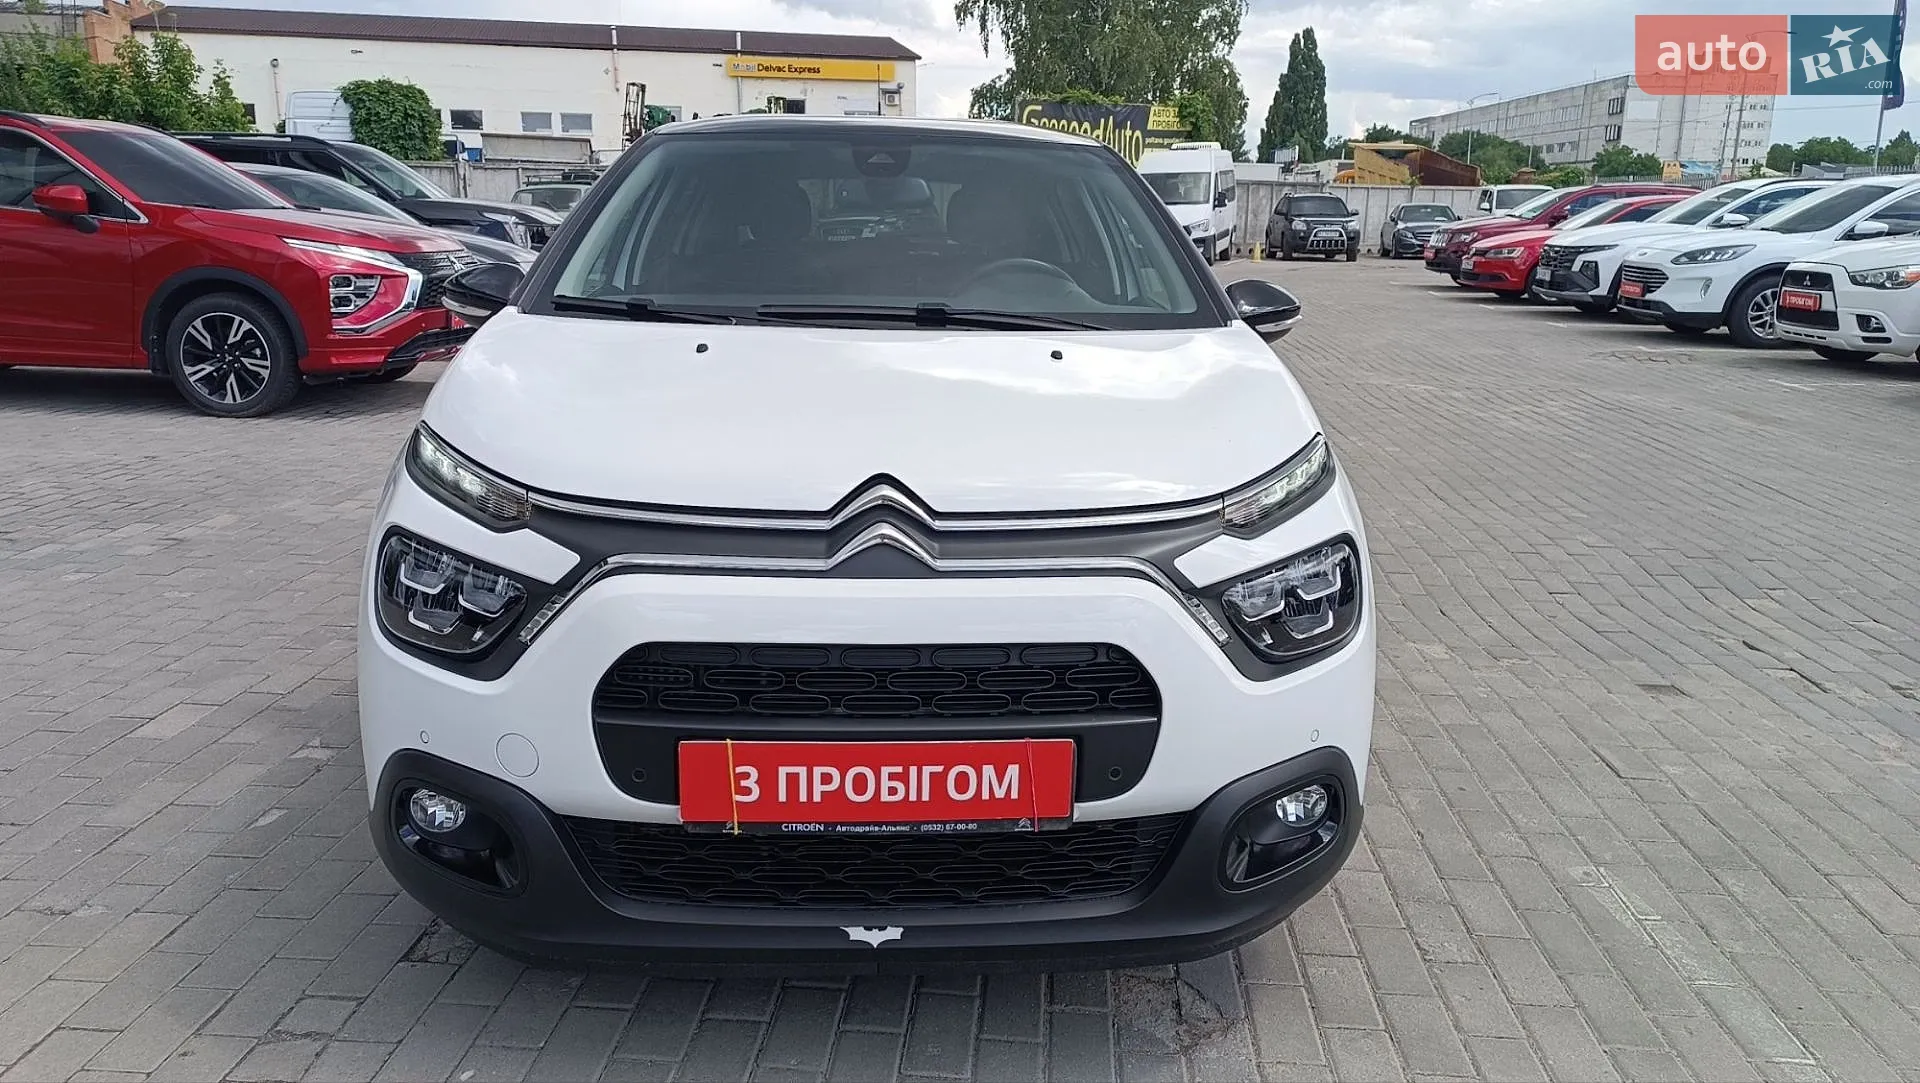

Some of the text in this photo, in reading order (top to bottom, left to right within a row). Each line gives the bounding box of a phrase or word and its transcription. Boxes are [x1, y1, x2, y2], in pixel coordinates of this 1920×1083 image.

[757, 64, 786, 73] Delvac
[787, 65, 821, 75] Express
[1152, 109, 1171, 118] АВТО
[1022, 104, 1143, 168] GdAuto
[735, 764, 1019, 802] З ПРОБІГОМ
[781, 822, 825, 832] CITROËN
